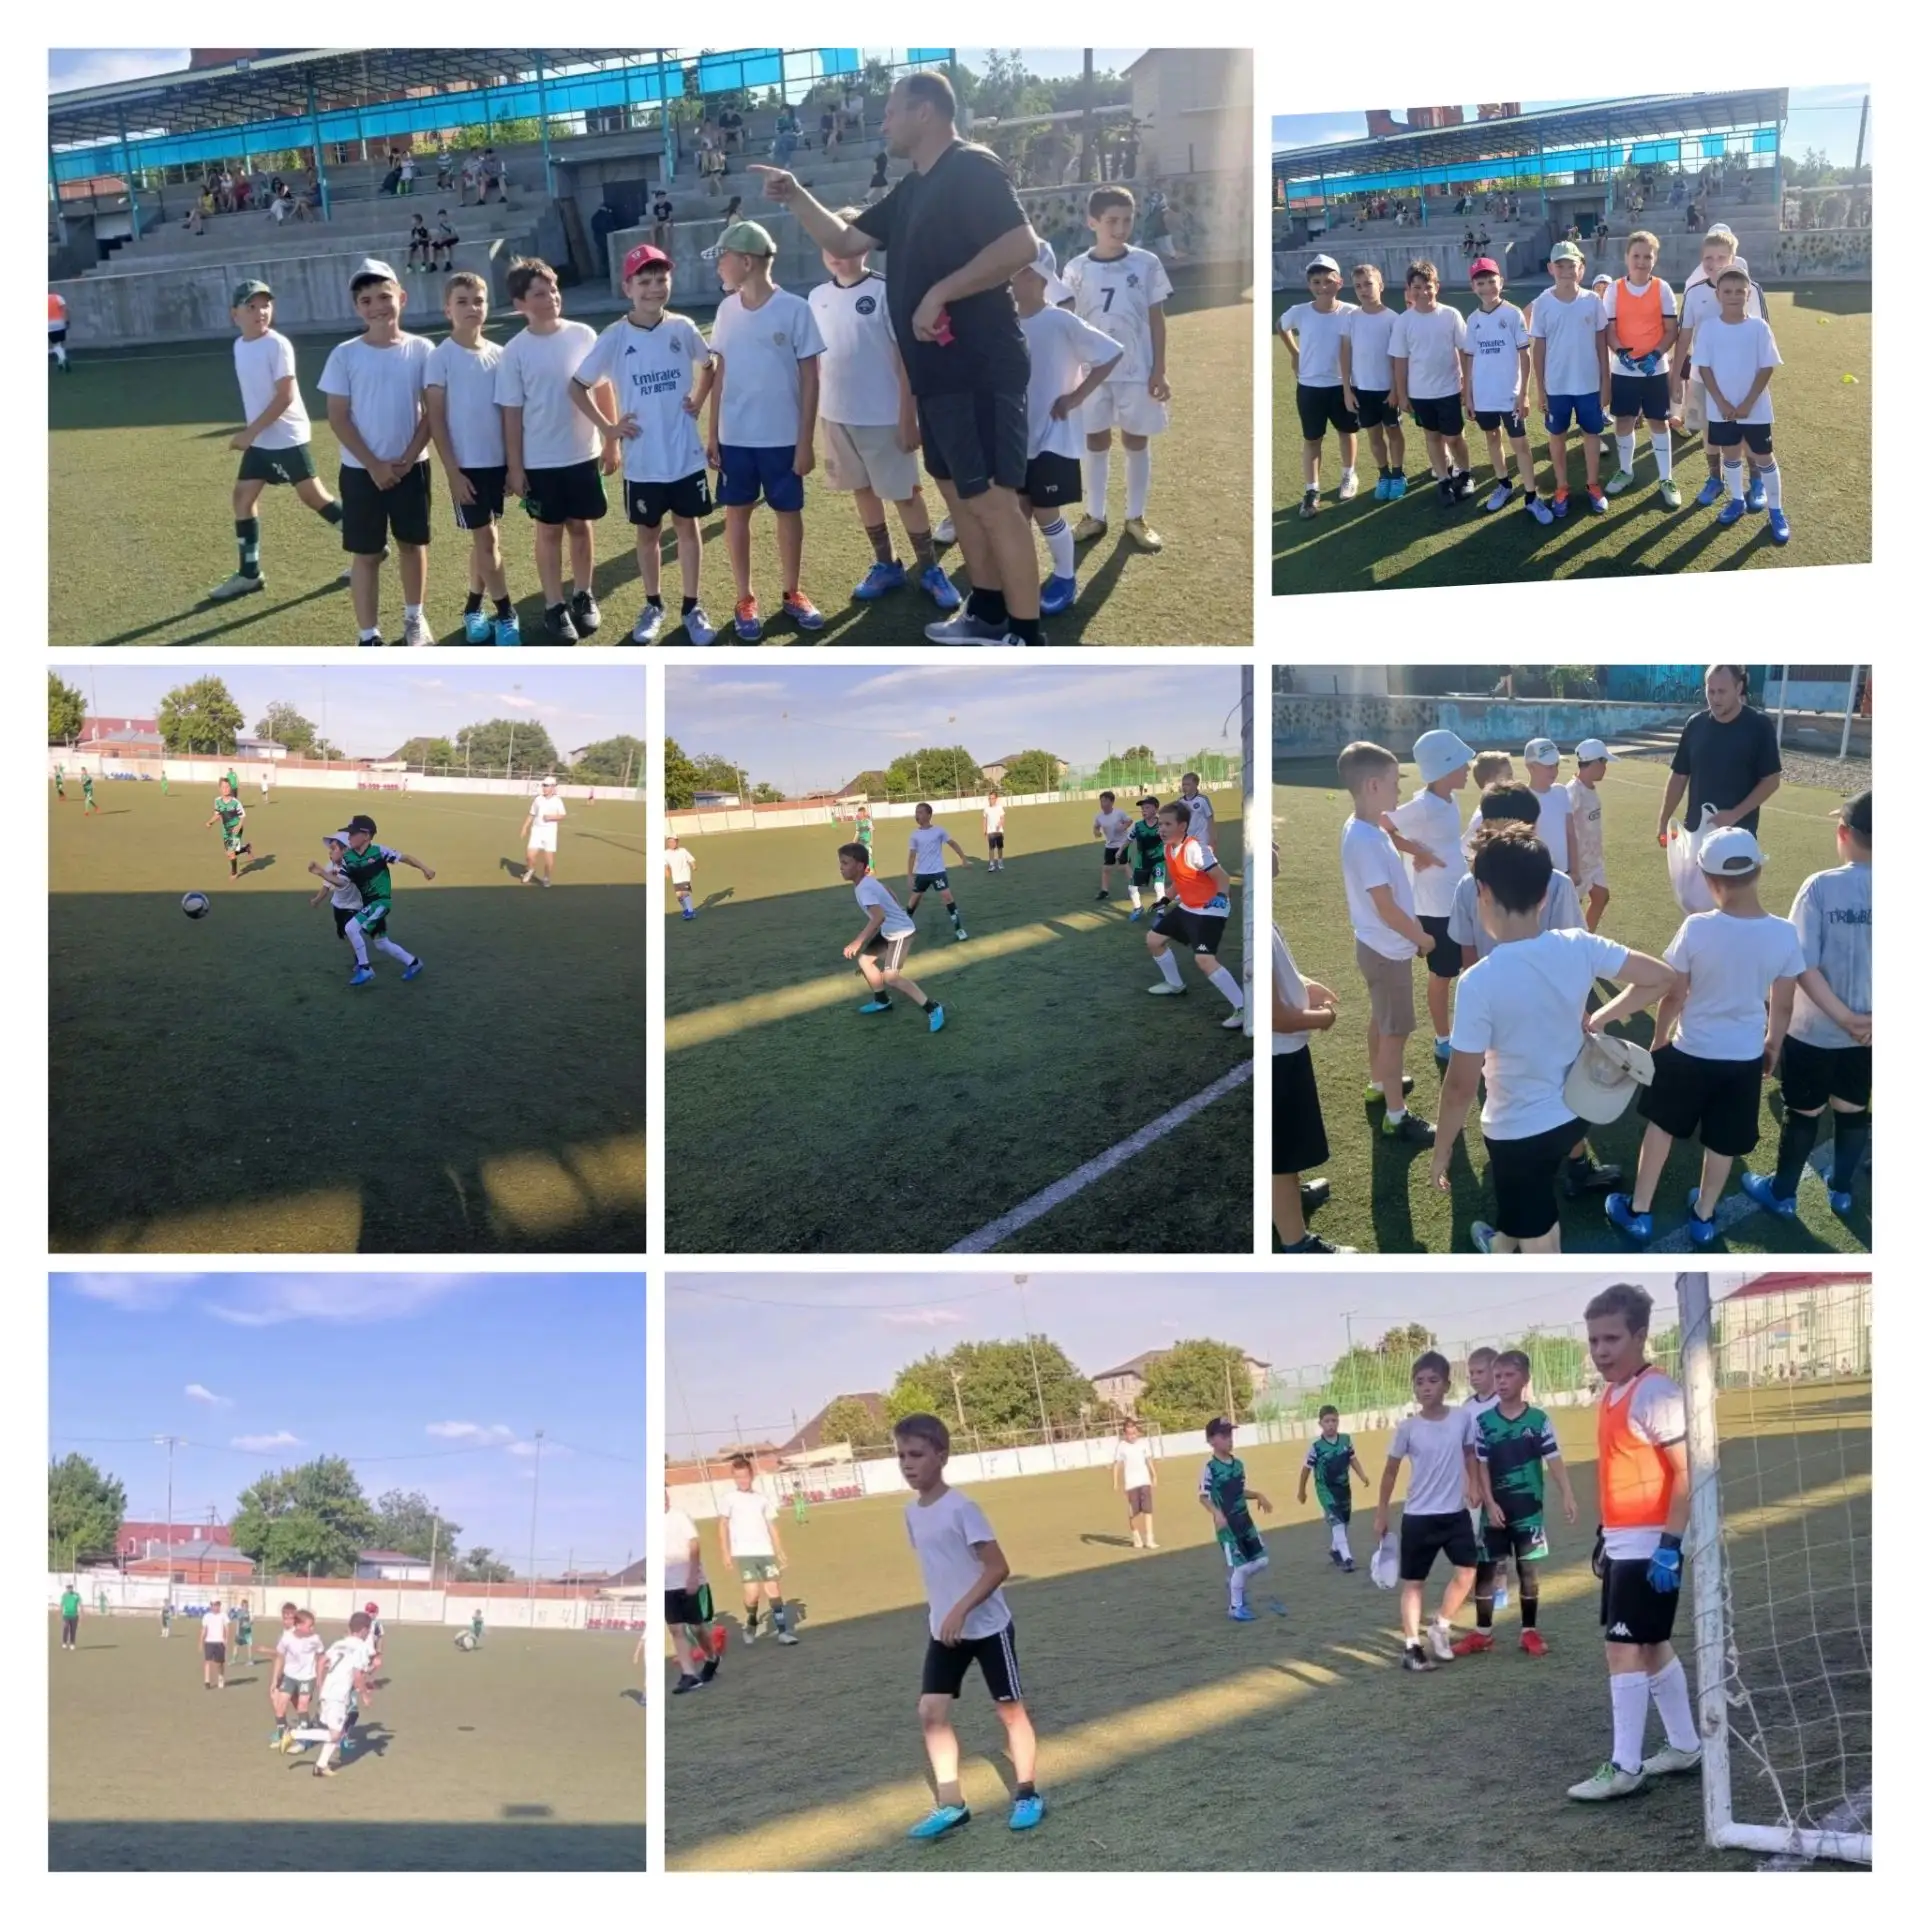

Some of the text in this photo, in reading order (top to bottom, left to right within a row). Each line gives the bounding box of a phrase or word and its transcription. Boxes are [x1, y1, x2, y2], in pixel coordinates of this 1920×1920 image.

[1101, 287, 1115, 313] 7
[632, 368, 681, 386] Emirates
[640, 385, 652, 396] FLY
[696, 478, 708, 503] 7
